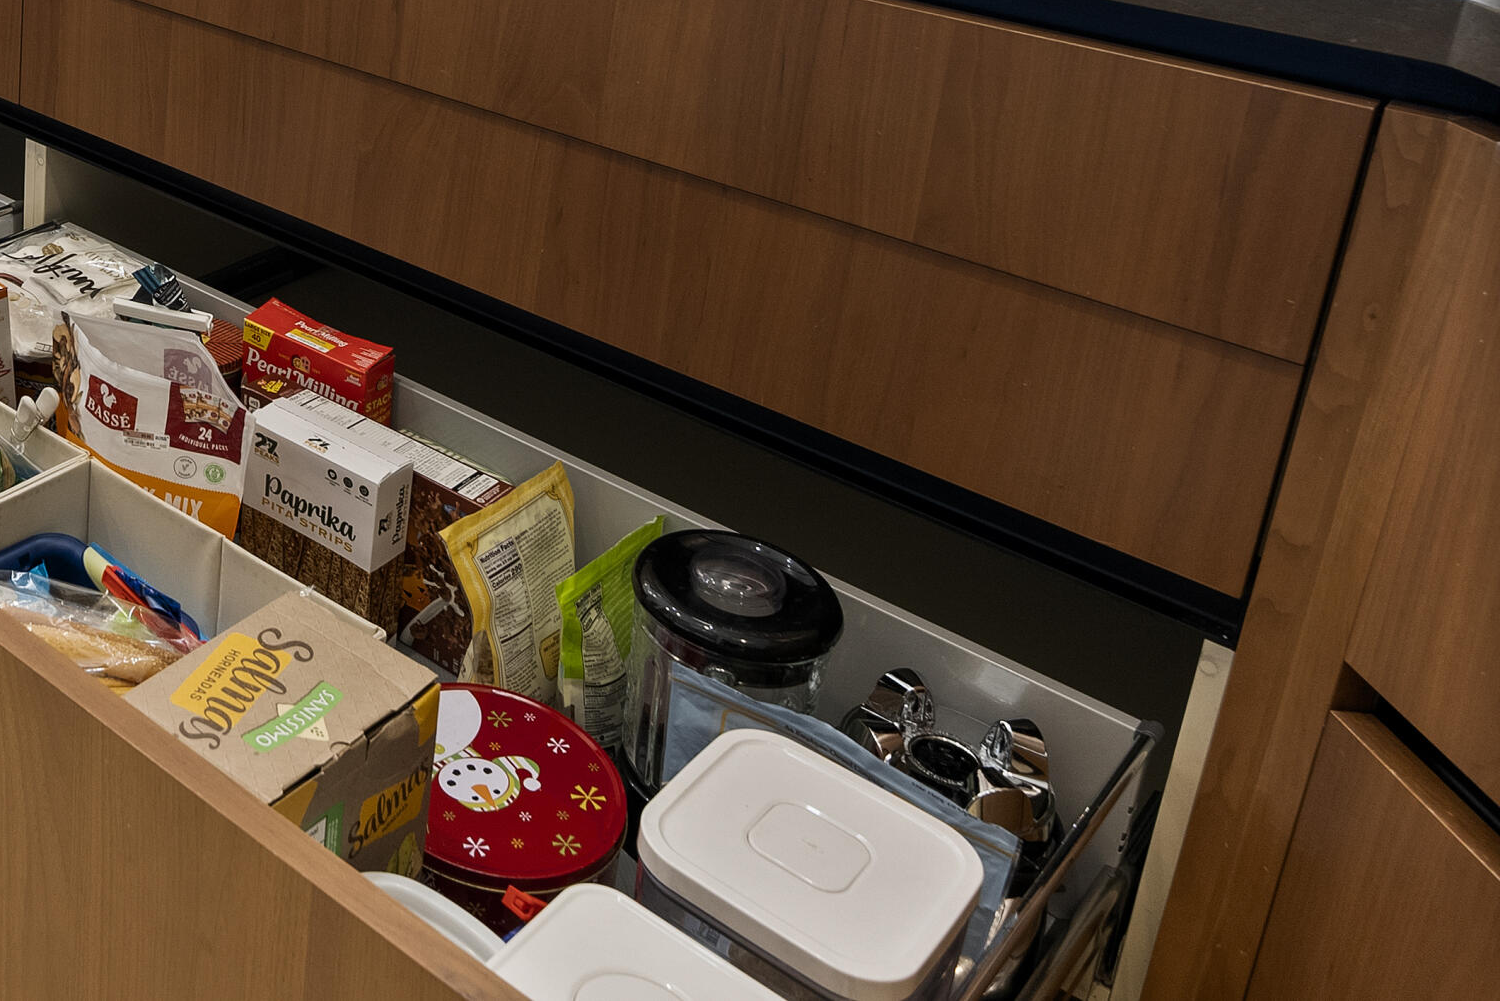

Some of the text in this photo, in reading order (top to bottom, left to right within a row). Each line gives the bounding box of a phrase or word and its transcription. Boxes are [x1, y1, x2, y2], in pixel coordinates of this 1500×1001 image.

[246, 346, 291, 380] Pearl
[87, 397, 132, 429] BASSÉ
[197, 427, 213, 442] 24
[179, 433, 210, 450] INDIVIDUAL
[164, 491, 204, 522] MIX
[261, 496, 296, 521] PITA
[299, 517, 354, 554] STRIPS
[265, 473, 356, 543] Paprika
[178, 626, 315, 750] Salmas
[189, 648, 242, 701] HORNEADAS
[254, 688, 336, 747] SANISSIMO
[347, 756, 430, 860] Salmas
